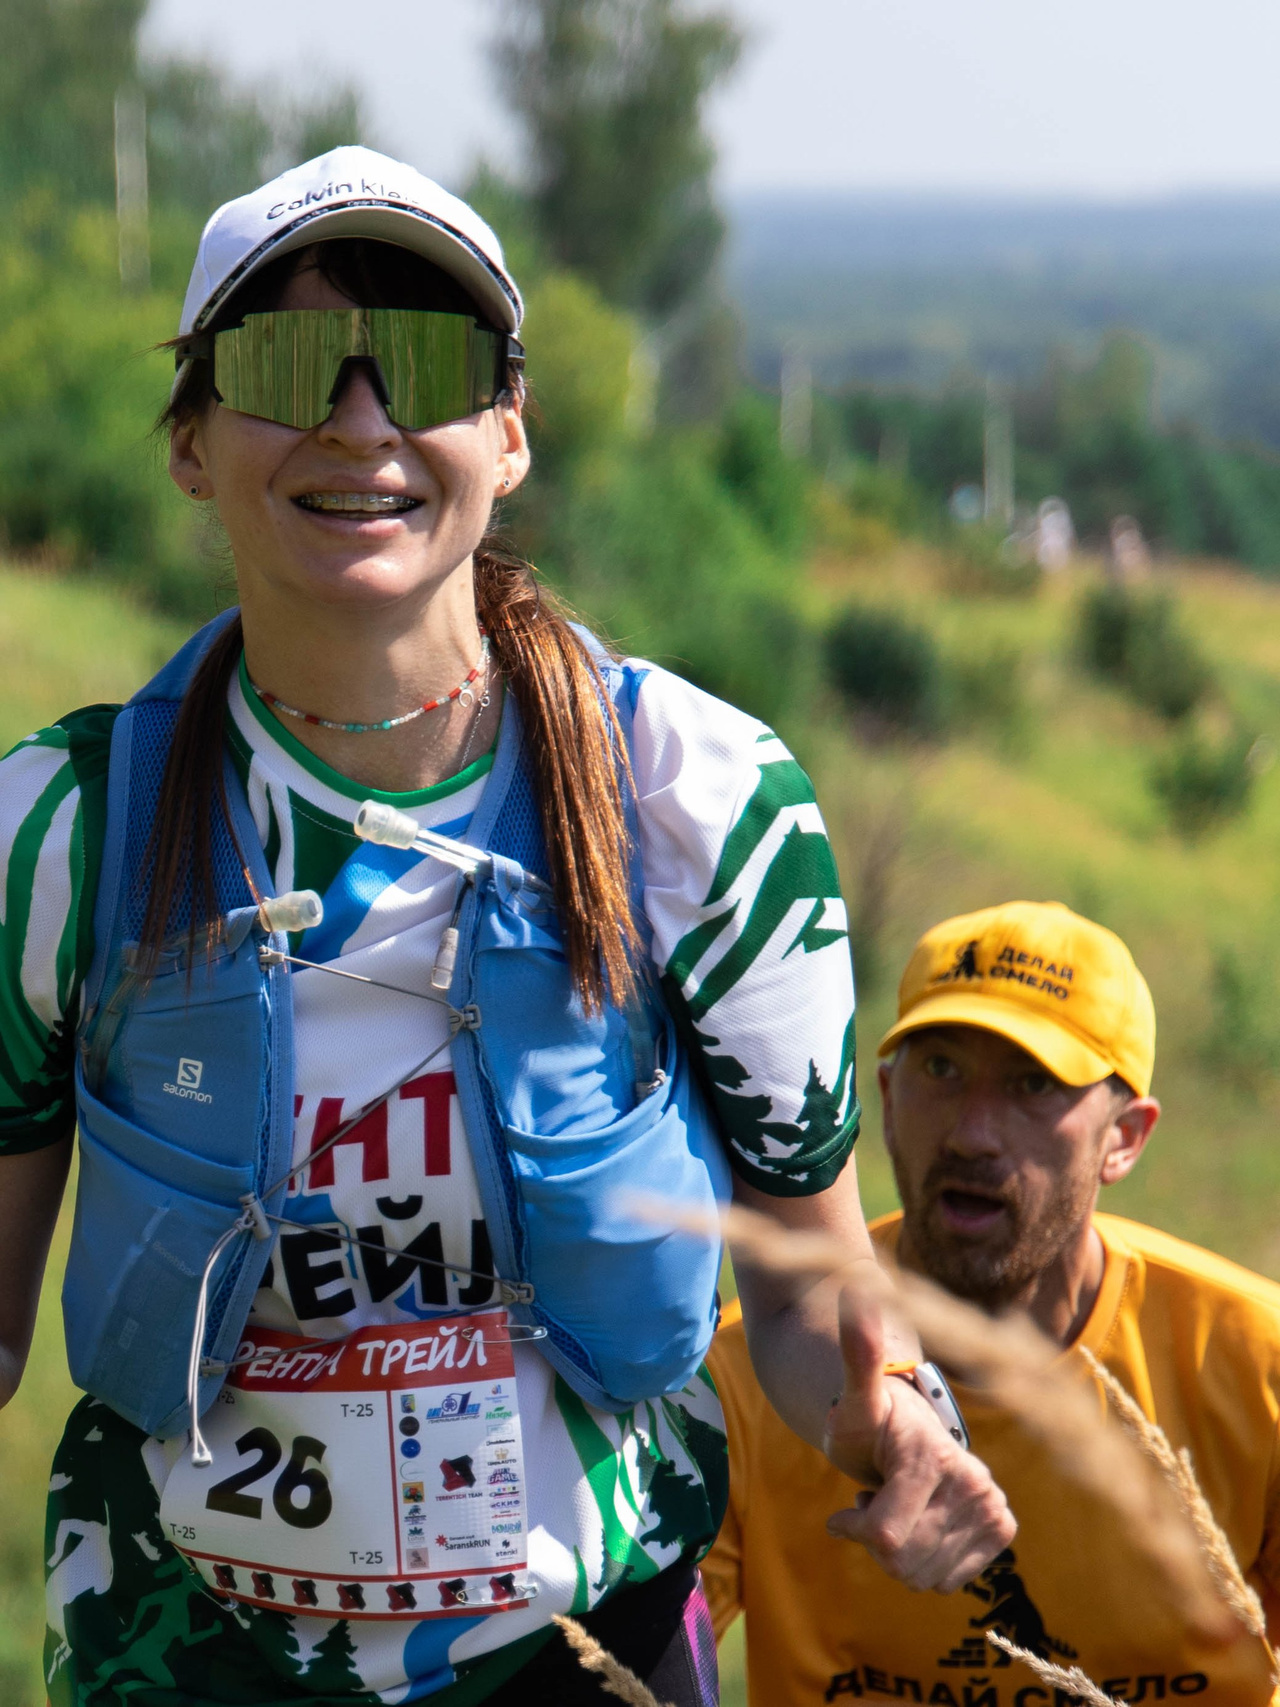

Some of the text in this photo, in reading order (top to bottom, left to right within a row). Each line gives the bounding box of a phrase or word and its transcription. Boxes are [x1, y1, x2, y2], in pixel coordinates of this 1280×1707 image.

[266, 178, 420, 220] Calvin Kle
[990, 965, 1068, 1001] СМЕЛО
[997, 946, 1074, 982] ДЕЛАЙ
[163, 1082, 213, 1104] salomon
[288, 1071, 458, 1191] НТ
[356, 1325, 488, 1376] ТРЕЙЛ
[205, 1426, 333, 1529] 26
[445, 1539, 491, 1551] SaranskRUN
[824, 1664, 997, 1707] ДЕЛАЙ
